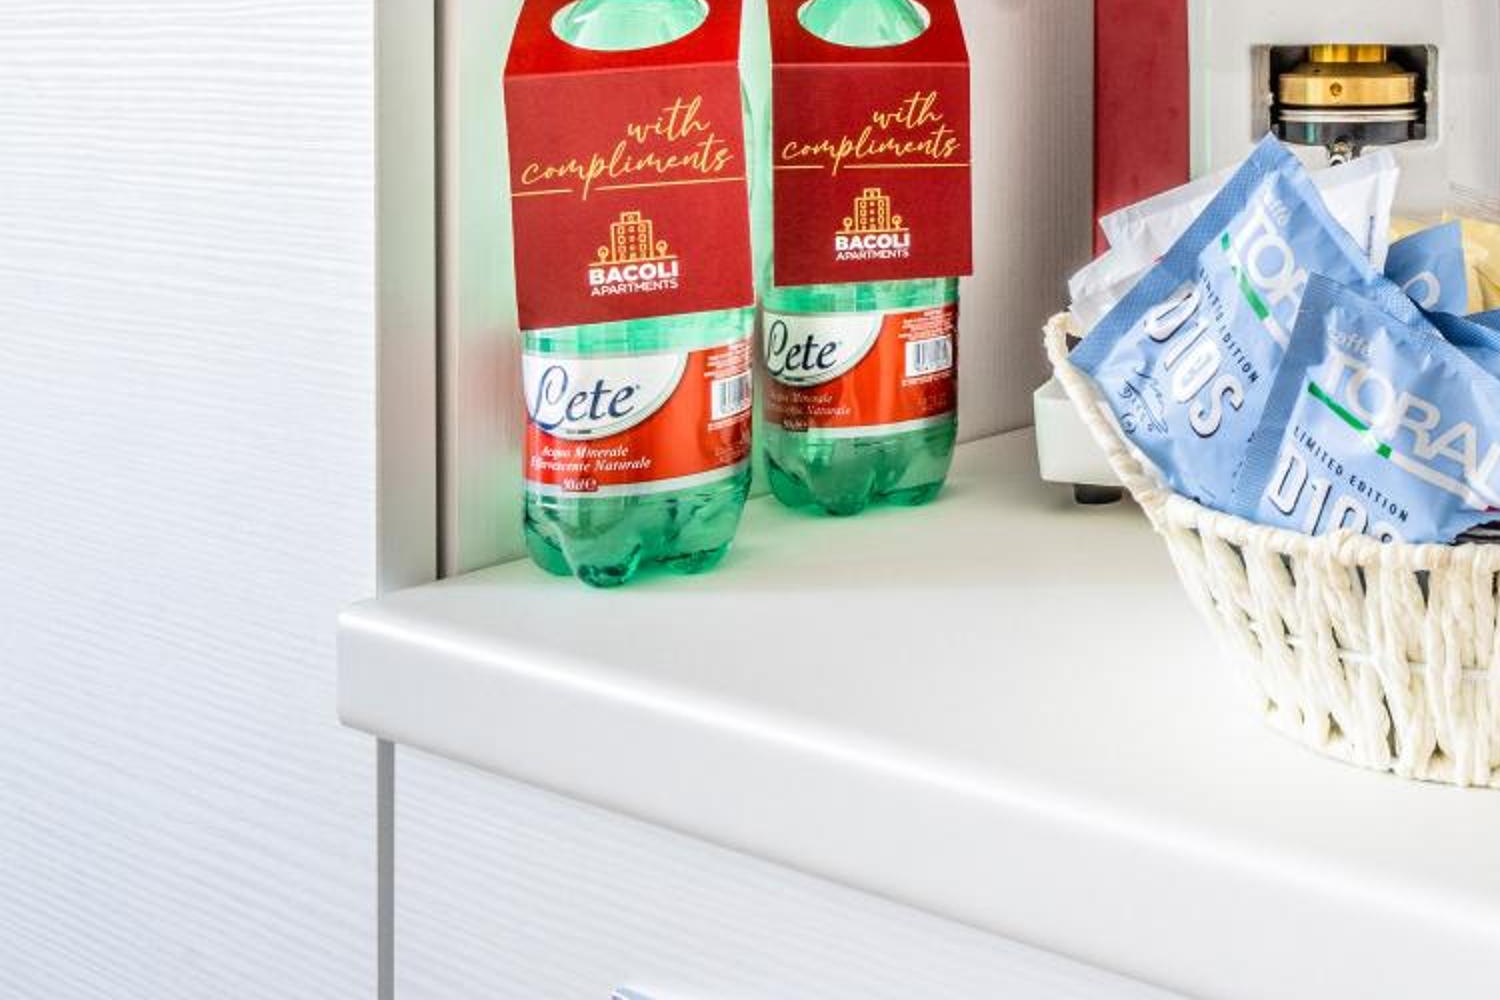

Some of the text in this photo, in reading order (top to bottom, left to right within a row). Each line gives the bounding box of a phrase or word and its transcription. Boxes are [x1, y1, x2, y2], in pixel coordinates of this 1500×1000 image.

[627, 95, 711, 143] with
[873, 91, 943, 129] with
[521, 133, 734, 200] compliments
[781, 124, 961, 176] compliments
[834, 232, 911, 251] BACOLI
[835, 248, 910, 262] APARTMENTS
[588, 260, 680, 285] BACOLI
[590, 278, 680, 297] APARTMENTS
[767, 320, 838, 376] Lete
[532, 365, 636, 430] Lete
[593, 455, 652, 471] Naturale
[1294, 426, 1408, 522] LIMITED EDITION
